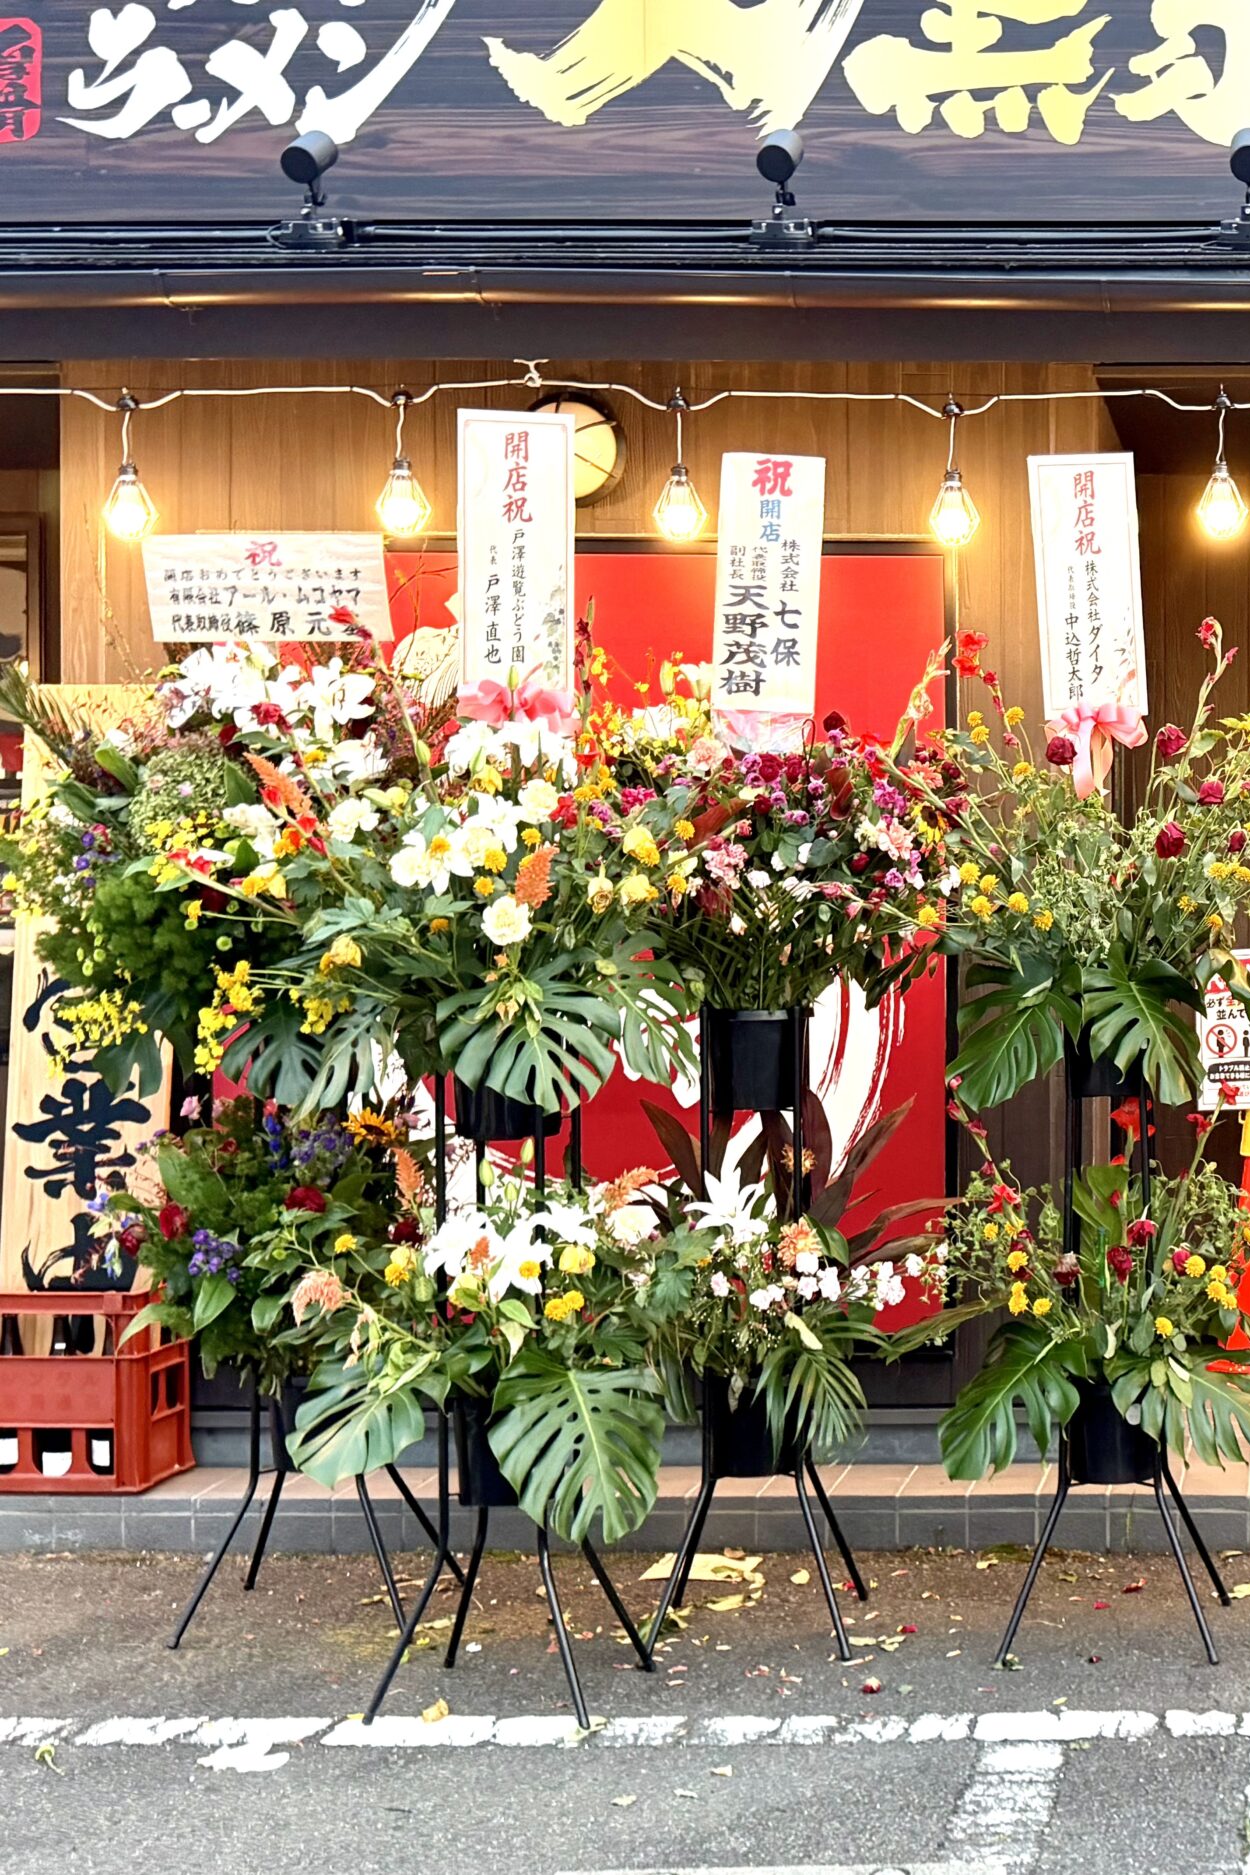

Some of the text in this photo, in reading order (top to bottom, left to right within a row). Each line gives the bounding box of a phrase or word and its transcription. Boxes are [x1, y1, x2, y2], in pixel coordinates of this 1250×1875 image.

[502, 430, 533, 523] 開店祝
[752, 458, 793, 497] 祝
[759, 499, 781, 543] 開店
[1073, 470, 1102, 556] 開店祝
[245, 541, 282, 567] 祝
[718, 584, 770, 697] 天野茂樹
